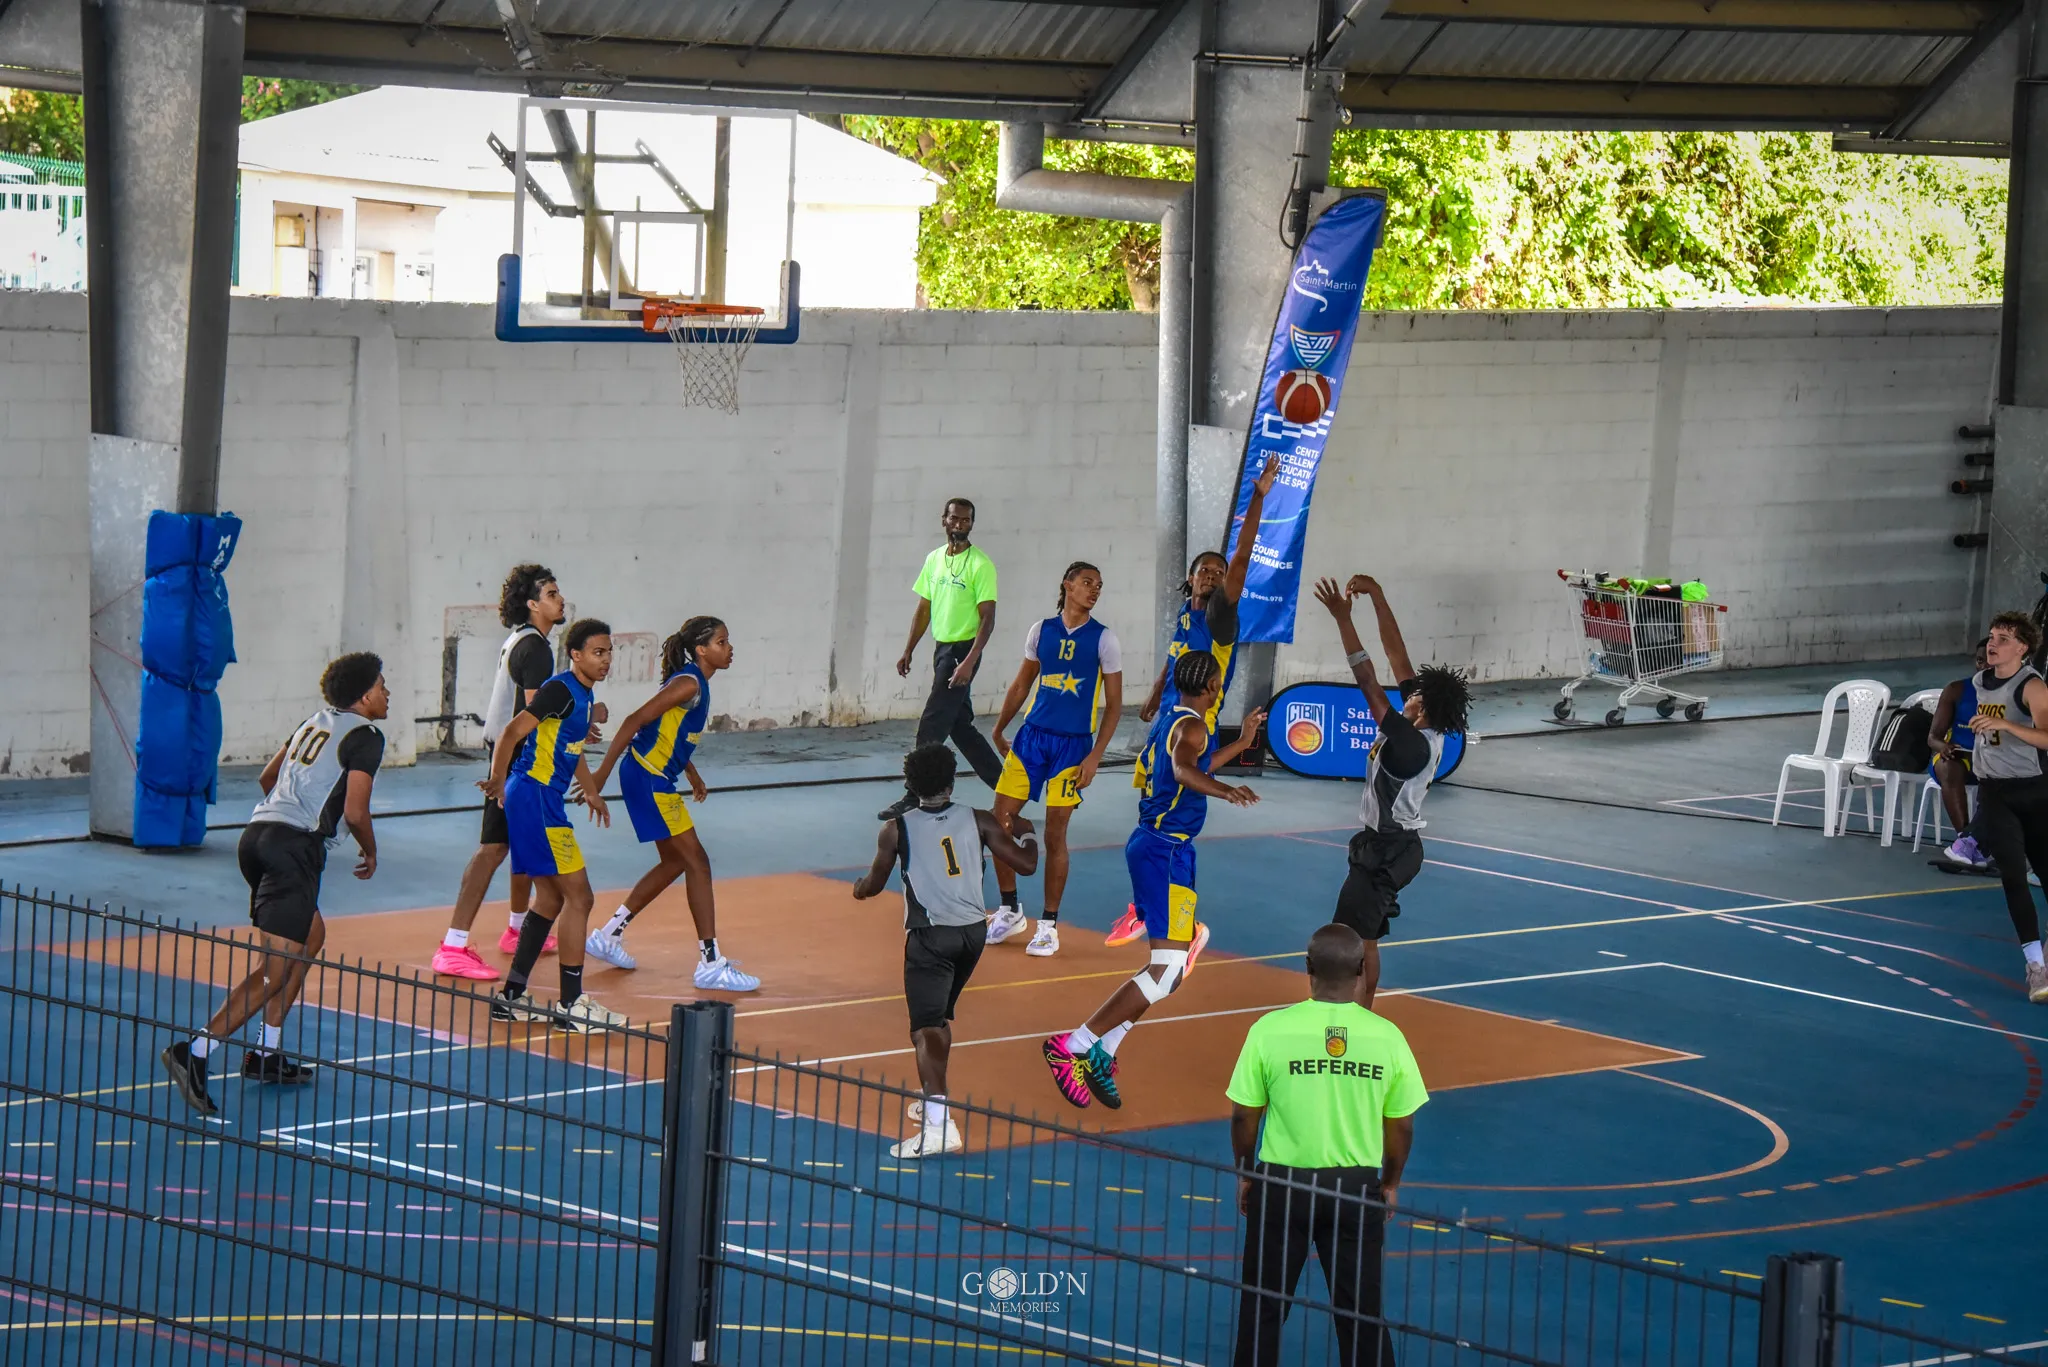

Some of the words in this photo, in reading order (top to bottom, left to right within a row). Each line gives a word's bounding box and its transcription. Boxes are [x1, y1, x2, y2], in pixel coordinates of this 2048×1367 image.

[1300, 272, 1357, 291] Saint-Martin
[1256, 458, 1264, 468] &
[1280, 474, 1291, 486] LE
[1252, 543, 1279, 559] COURS
[1250, 552, 1293, 570] FORMANCE
[1058, 638, 1076, 661] 13
[290, 726, 331, 767] 10
[1061, 778, 1077, 798] 13
[941, 835, 962, 878] 1
[1289, 1059, 1384, 1081] REFEREE
